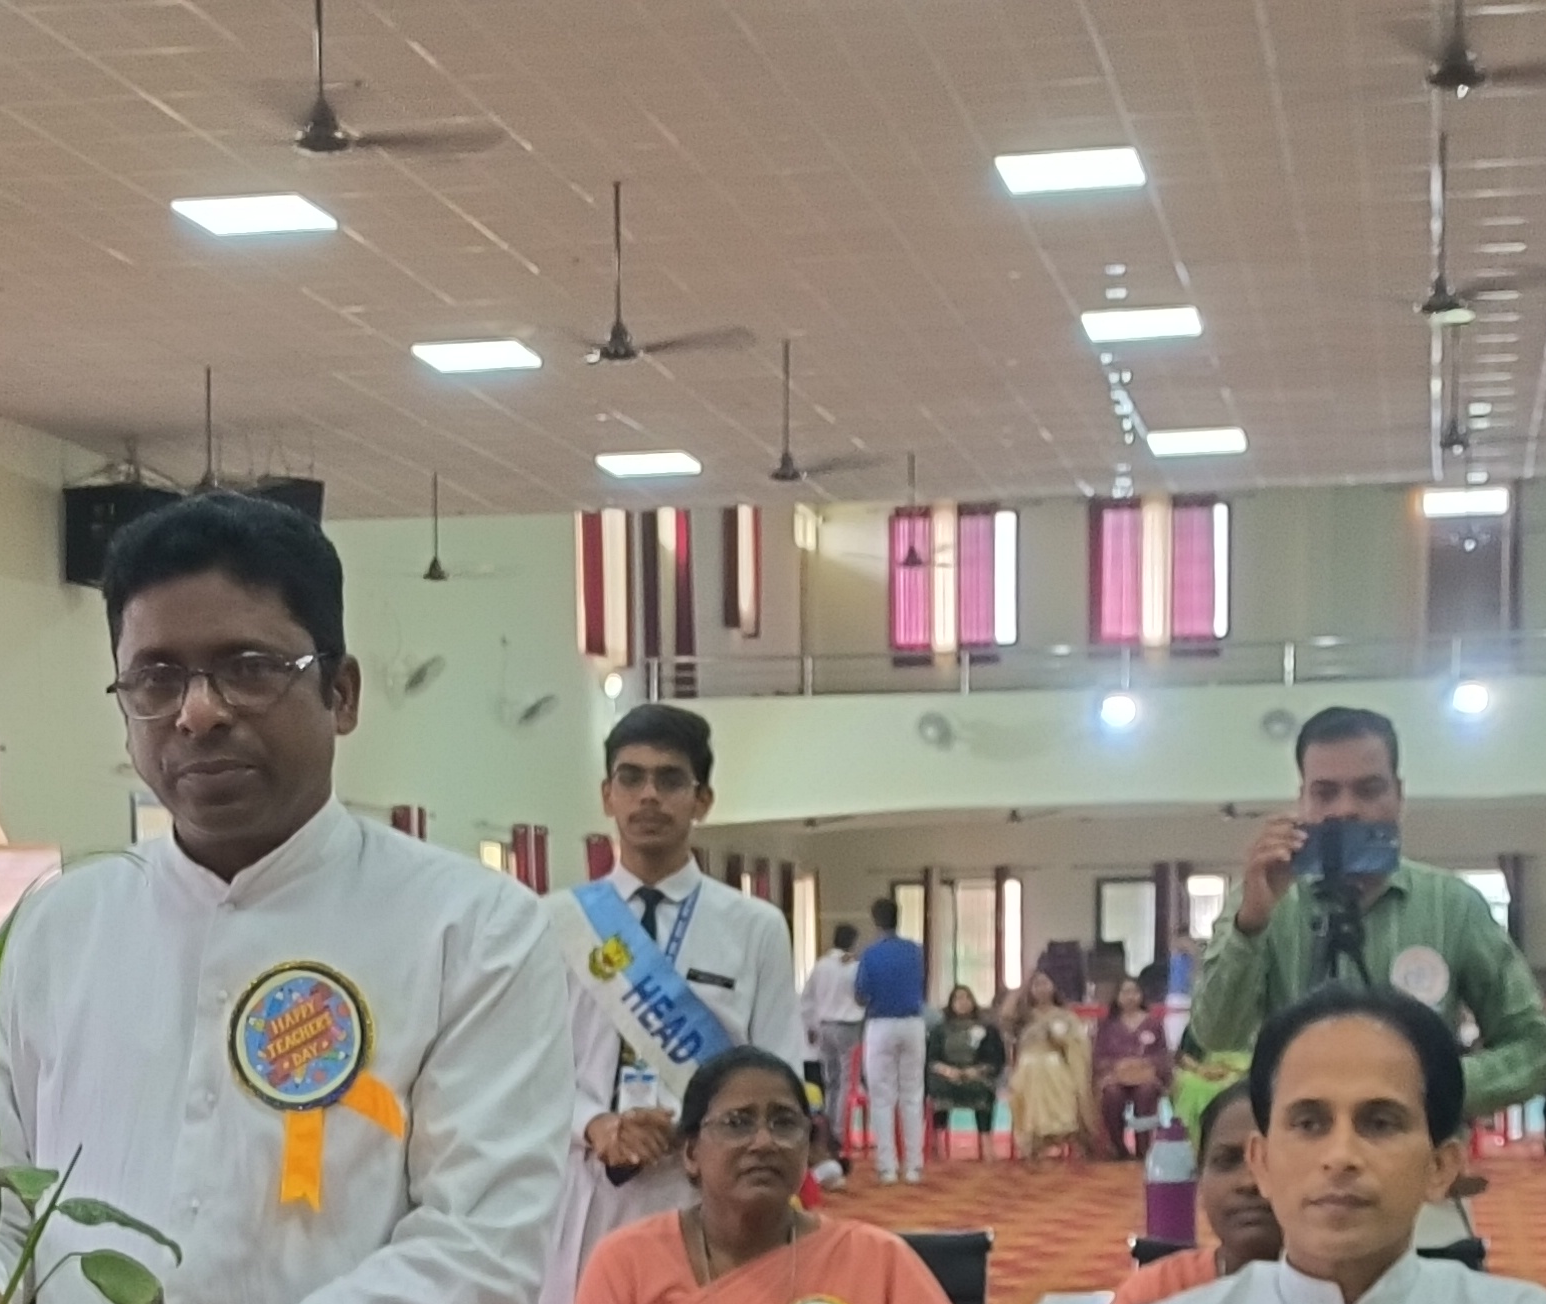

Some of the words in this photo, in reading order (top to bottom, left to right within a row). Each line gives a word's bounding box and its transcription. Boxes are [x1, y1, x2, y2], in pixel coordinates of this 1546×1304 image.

[270, 1001, 316, 1035] HAPPY
[621, 975, 704, 1065] HEAD
[291, 1041, 319, 1068] DAY
